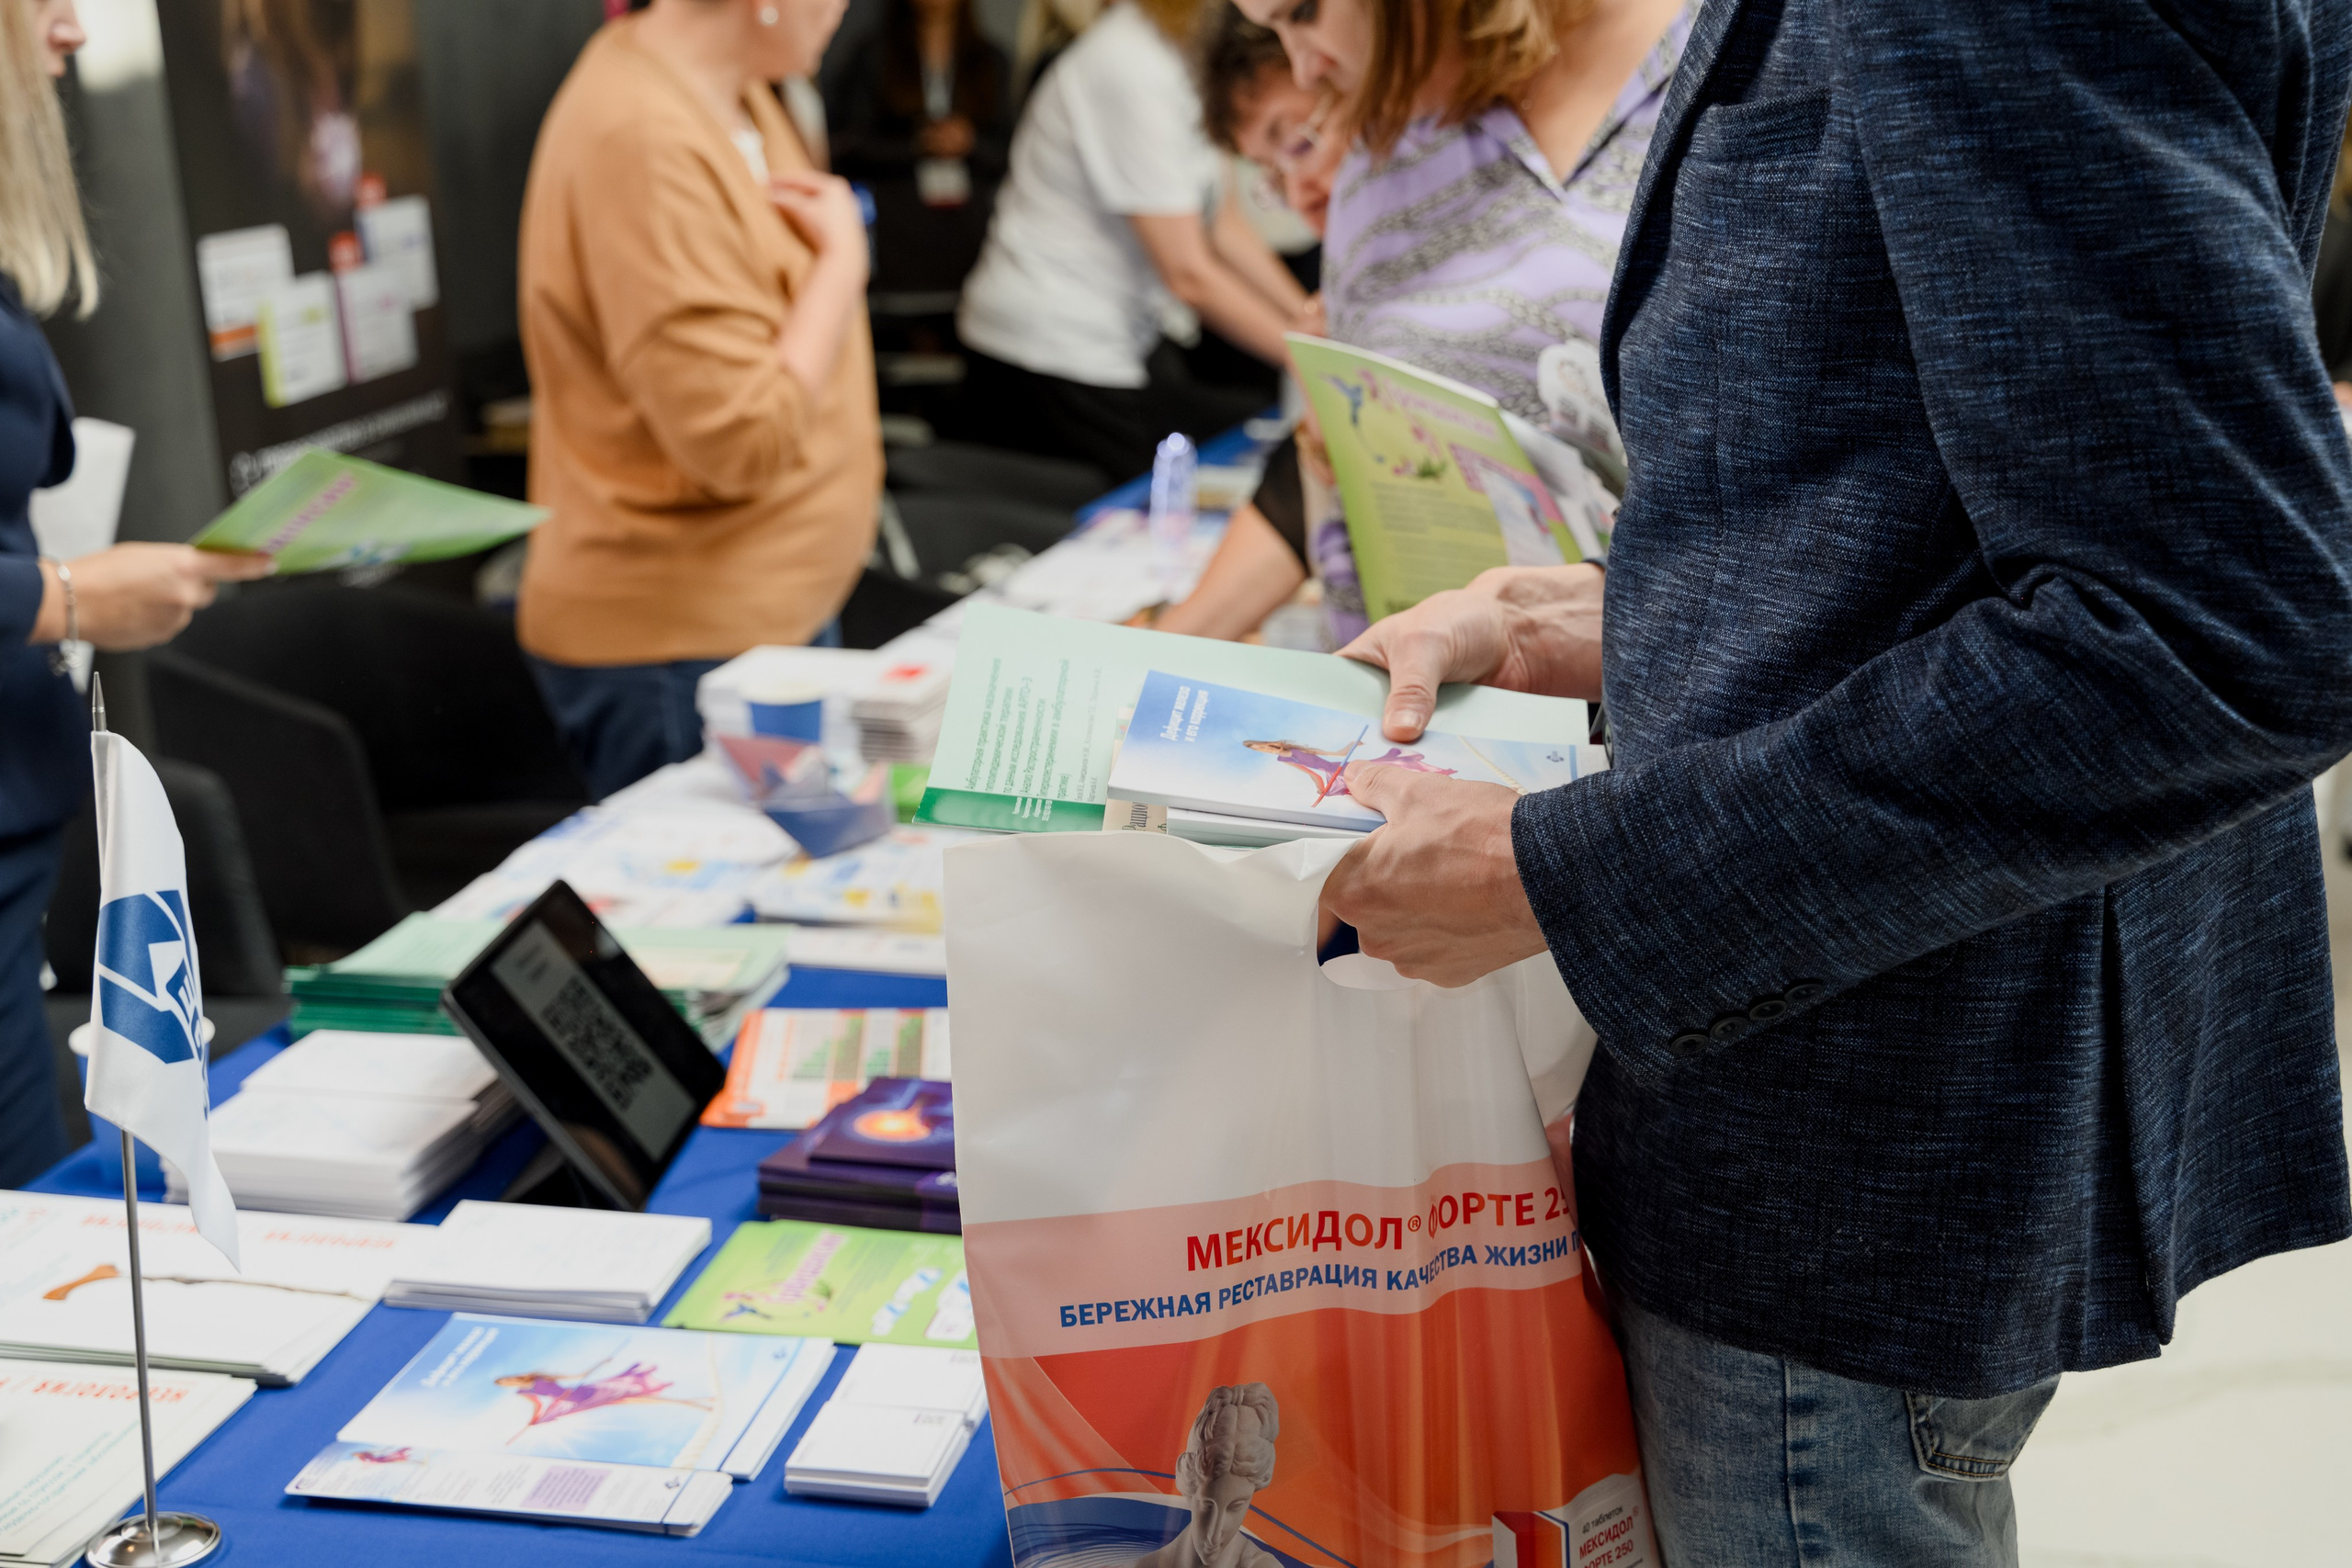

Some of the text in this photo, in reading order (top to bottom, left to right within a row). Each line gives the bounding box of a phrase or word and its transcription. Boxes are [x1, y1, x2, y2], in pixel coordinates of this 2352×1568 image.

[1059, 1292, 1211, 1328] БЕРЕЖНАЯ
[1218, 1263, 1377, 1310] РЕСТАВРАЦИЯ
[1386, 1245, 1478, 1291] КАЧЕСТВА
[1484, 1235, 1568, 1267] ЖИЗНИ
[1581, 1506, 1623, 1534] 40 таблеток
[1614, 1539, 1634, 1560] 250
